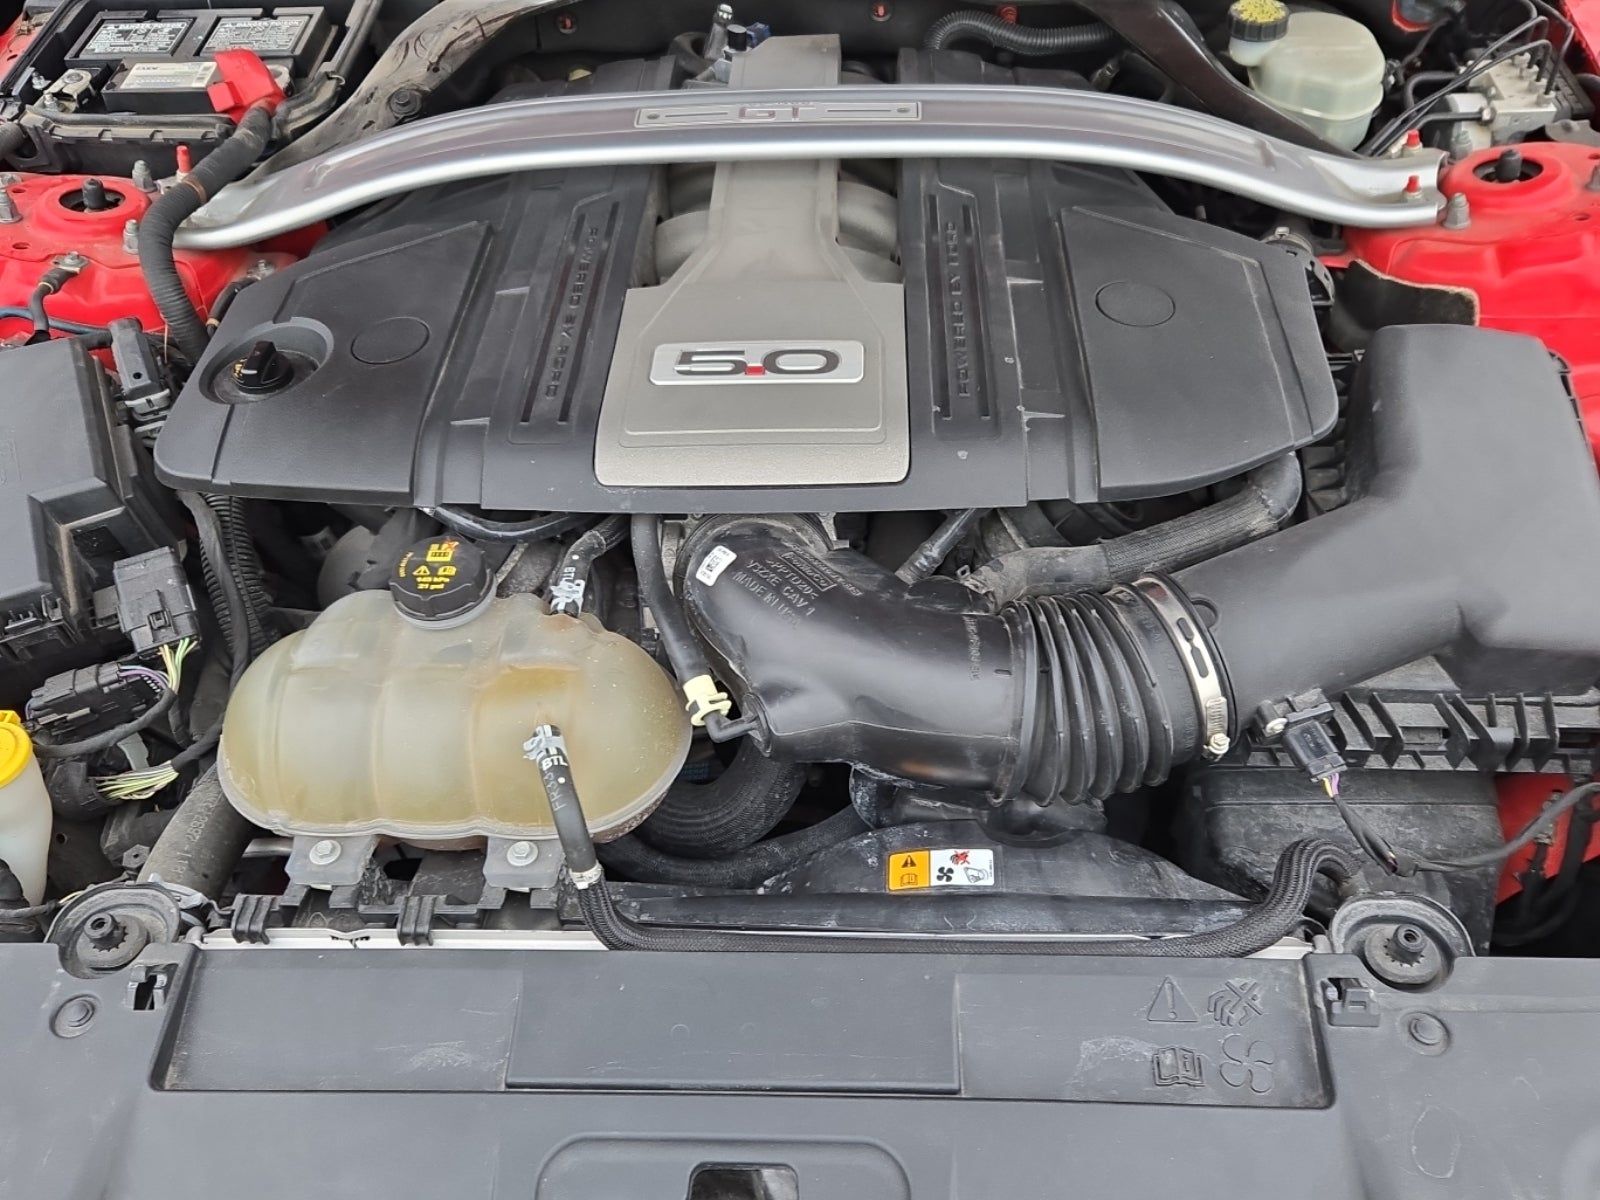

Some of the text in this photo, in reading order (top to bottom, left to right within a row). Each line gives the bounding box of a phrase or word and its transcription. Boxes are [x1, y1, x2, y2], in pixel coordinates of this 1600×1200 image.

[739, 106, 817, 121] GT
[950, 274, 962, 295] BY
[545, 226, 598, 399] POWERED BY FORD
[674, 348, 840, 376] 5.0
[952, 301, 971, 397] POWERED
[732, 571, 768, 597] MADE
[541, 755, 568, 771] BTL
